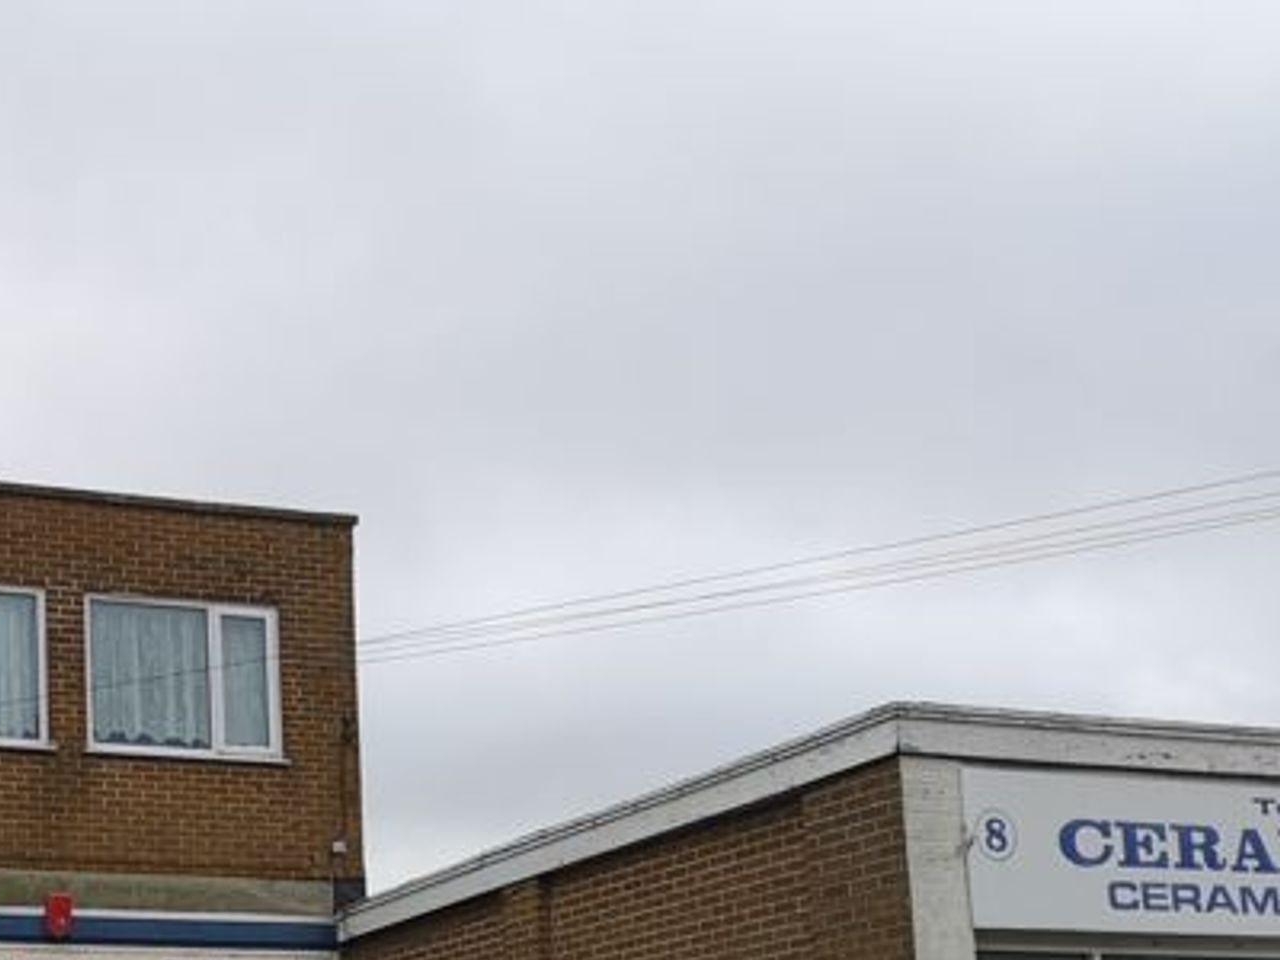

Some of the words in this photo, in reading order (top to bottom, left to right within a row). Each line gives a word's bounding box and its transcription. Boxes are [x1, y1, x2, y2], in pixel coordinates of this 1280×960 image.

[1254, 797, 1280, 814] T
[985, 818, 1007, 852] 8
[1058, 819, 1280, 873] CERA
[1108, 882, 1280, 914] CERAM
